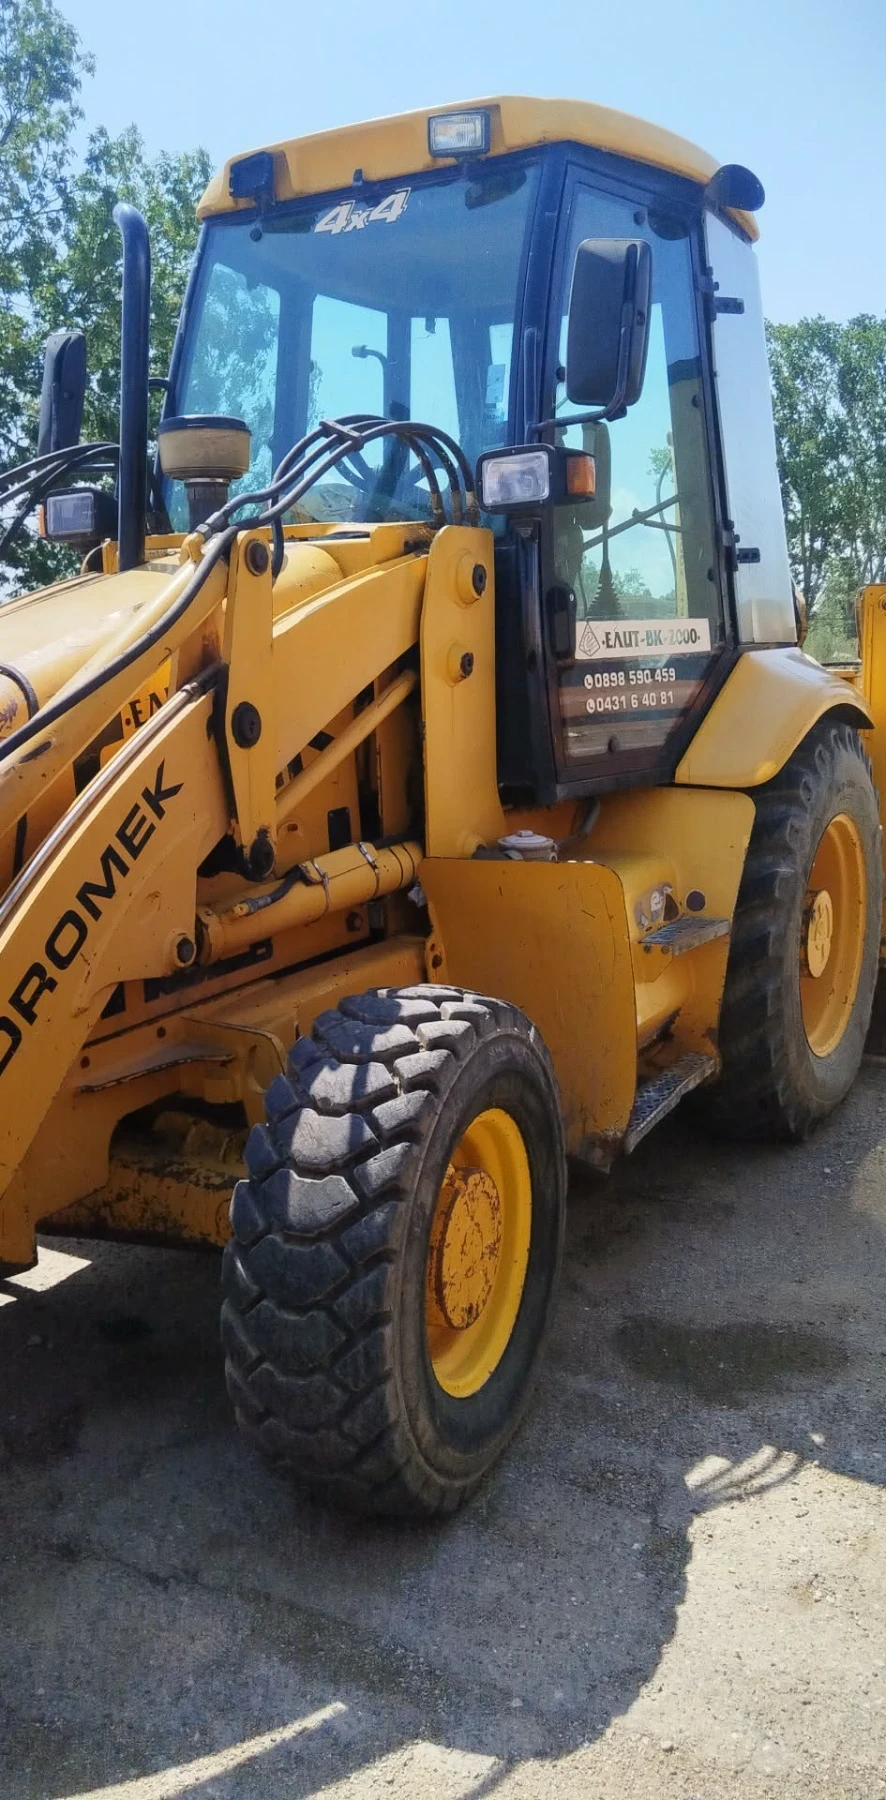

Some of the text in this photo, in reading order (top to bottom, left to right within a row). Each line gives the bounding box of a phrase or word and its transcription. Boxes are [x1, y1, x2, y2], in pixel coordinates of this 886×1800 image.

[314, 187, 411, 235] 4x4
[595, 667, 676, 688] 0898 590 459
[596, 691, 674, 712] 0431 6 40 81
